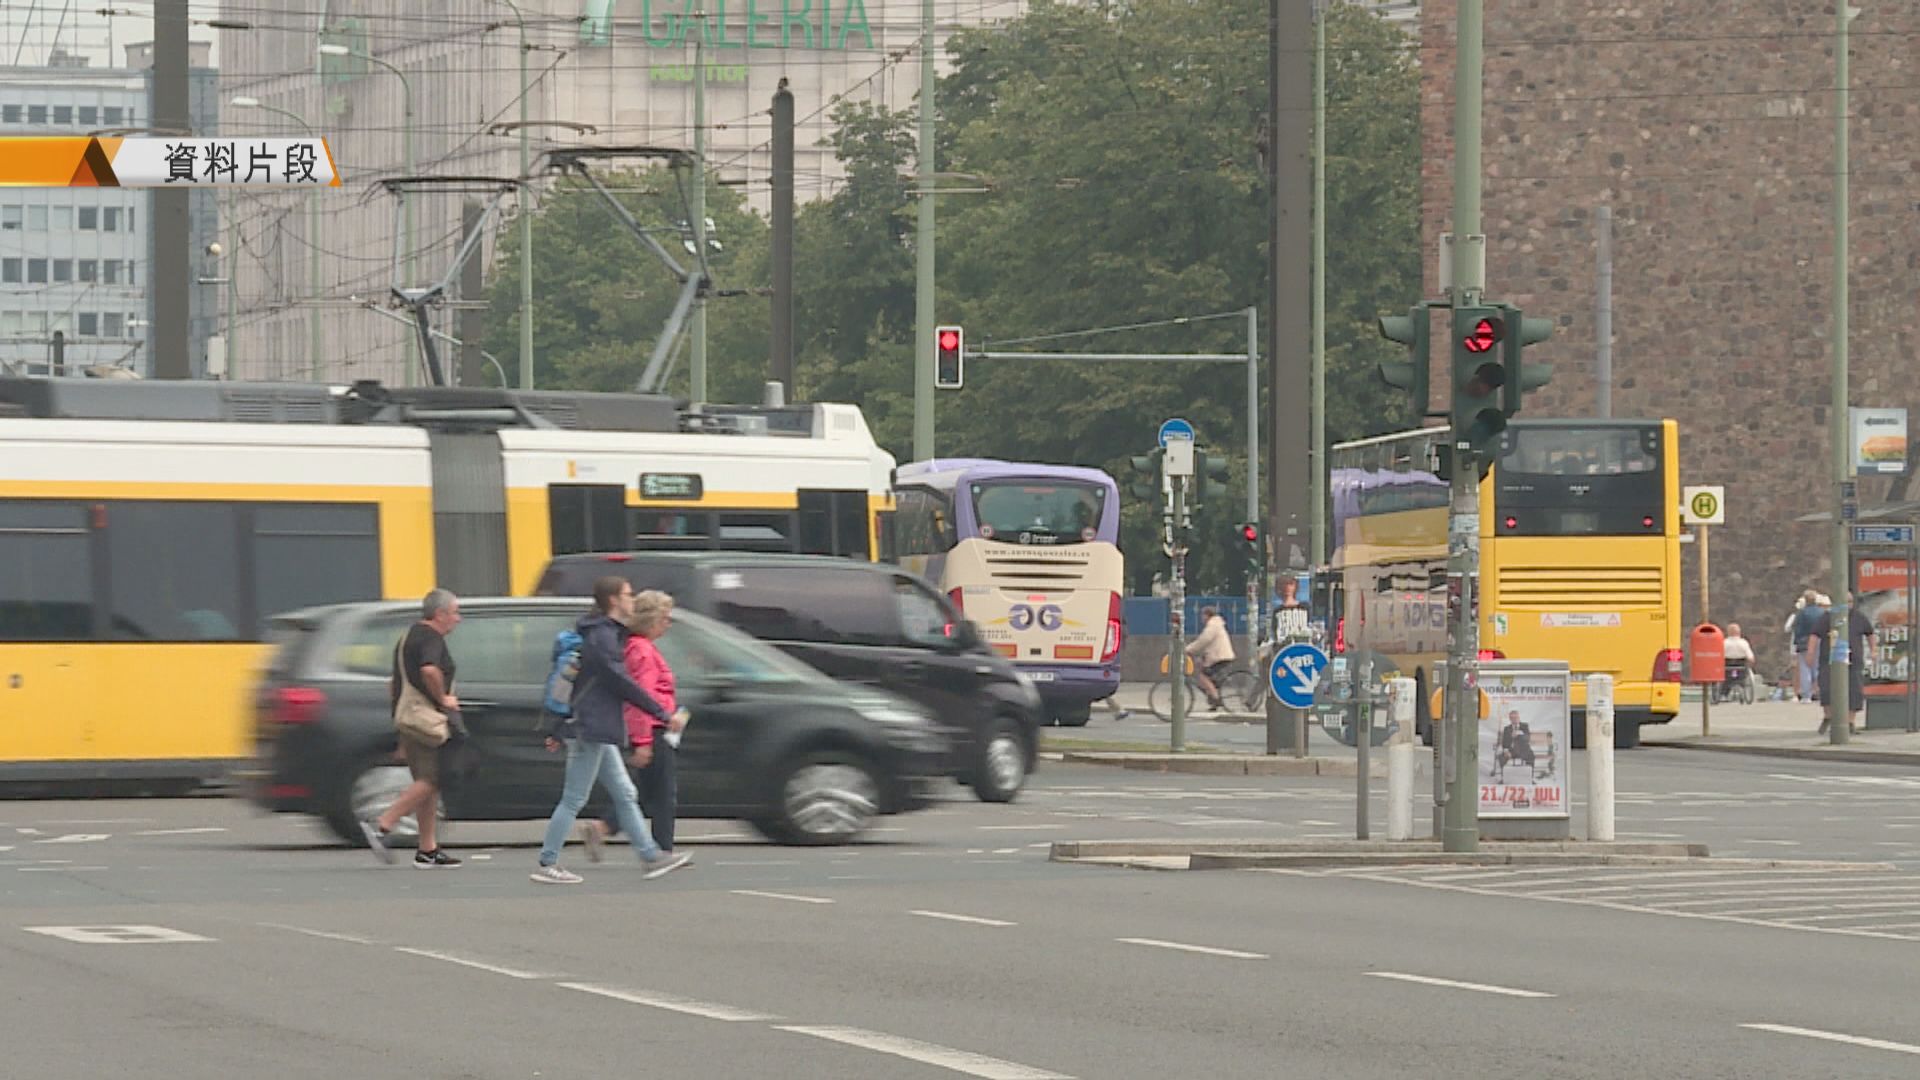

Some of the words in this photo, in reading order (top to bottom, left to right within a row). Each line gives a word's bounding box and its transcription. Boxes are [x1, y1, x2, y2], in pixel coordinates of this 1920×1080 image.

[642, 0, 875, 49] GALERIA
[1521, 685, 1563, 695] FREITAG
[1532, 786, 1560, 801] JULI
